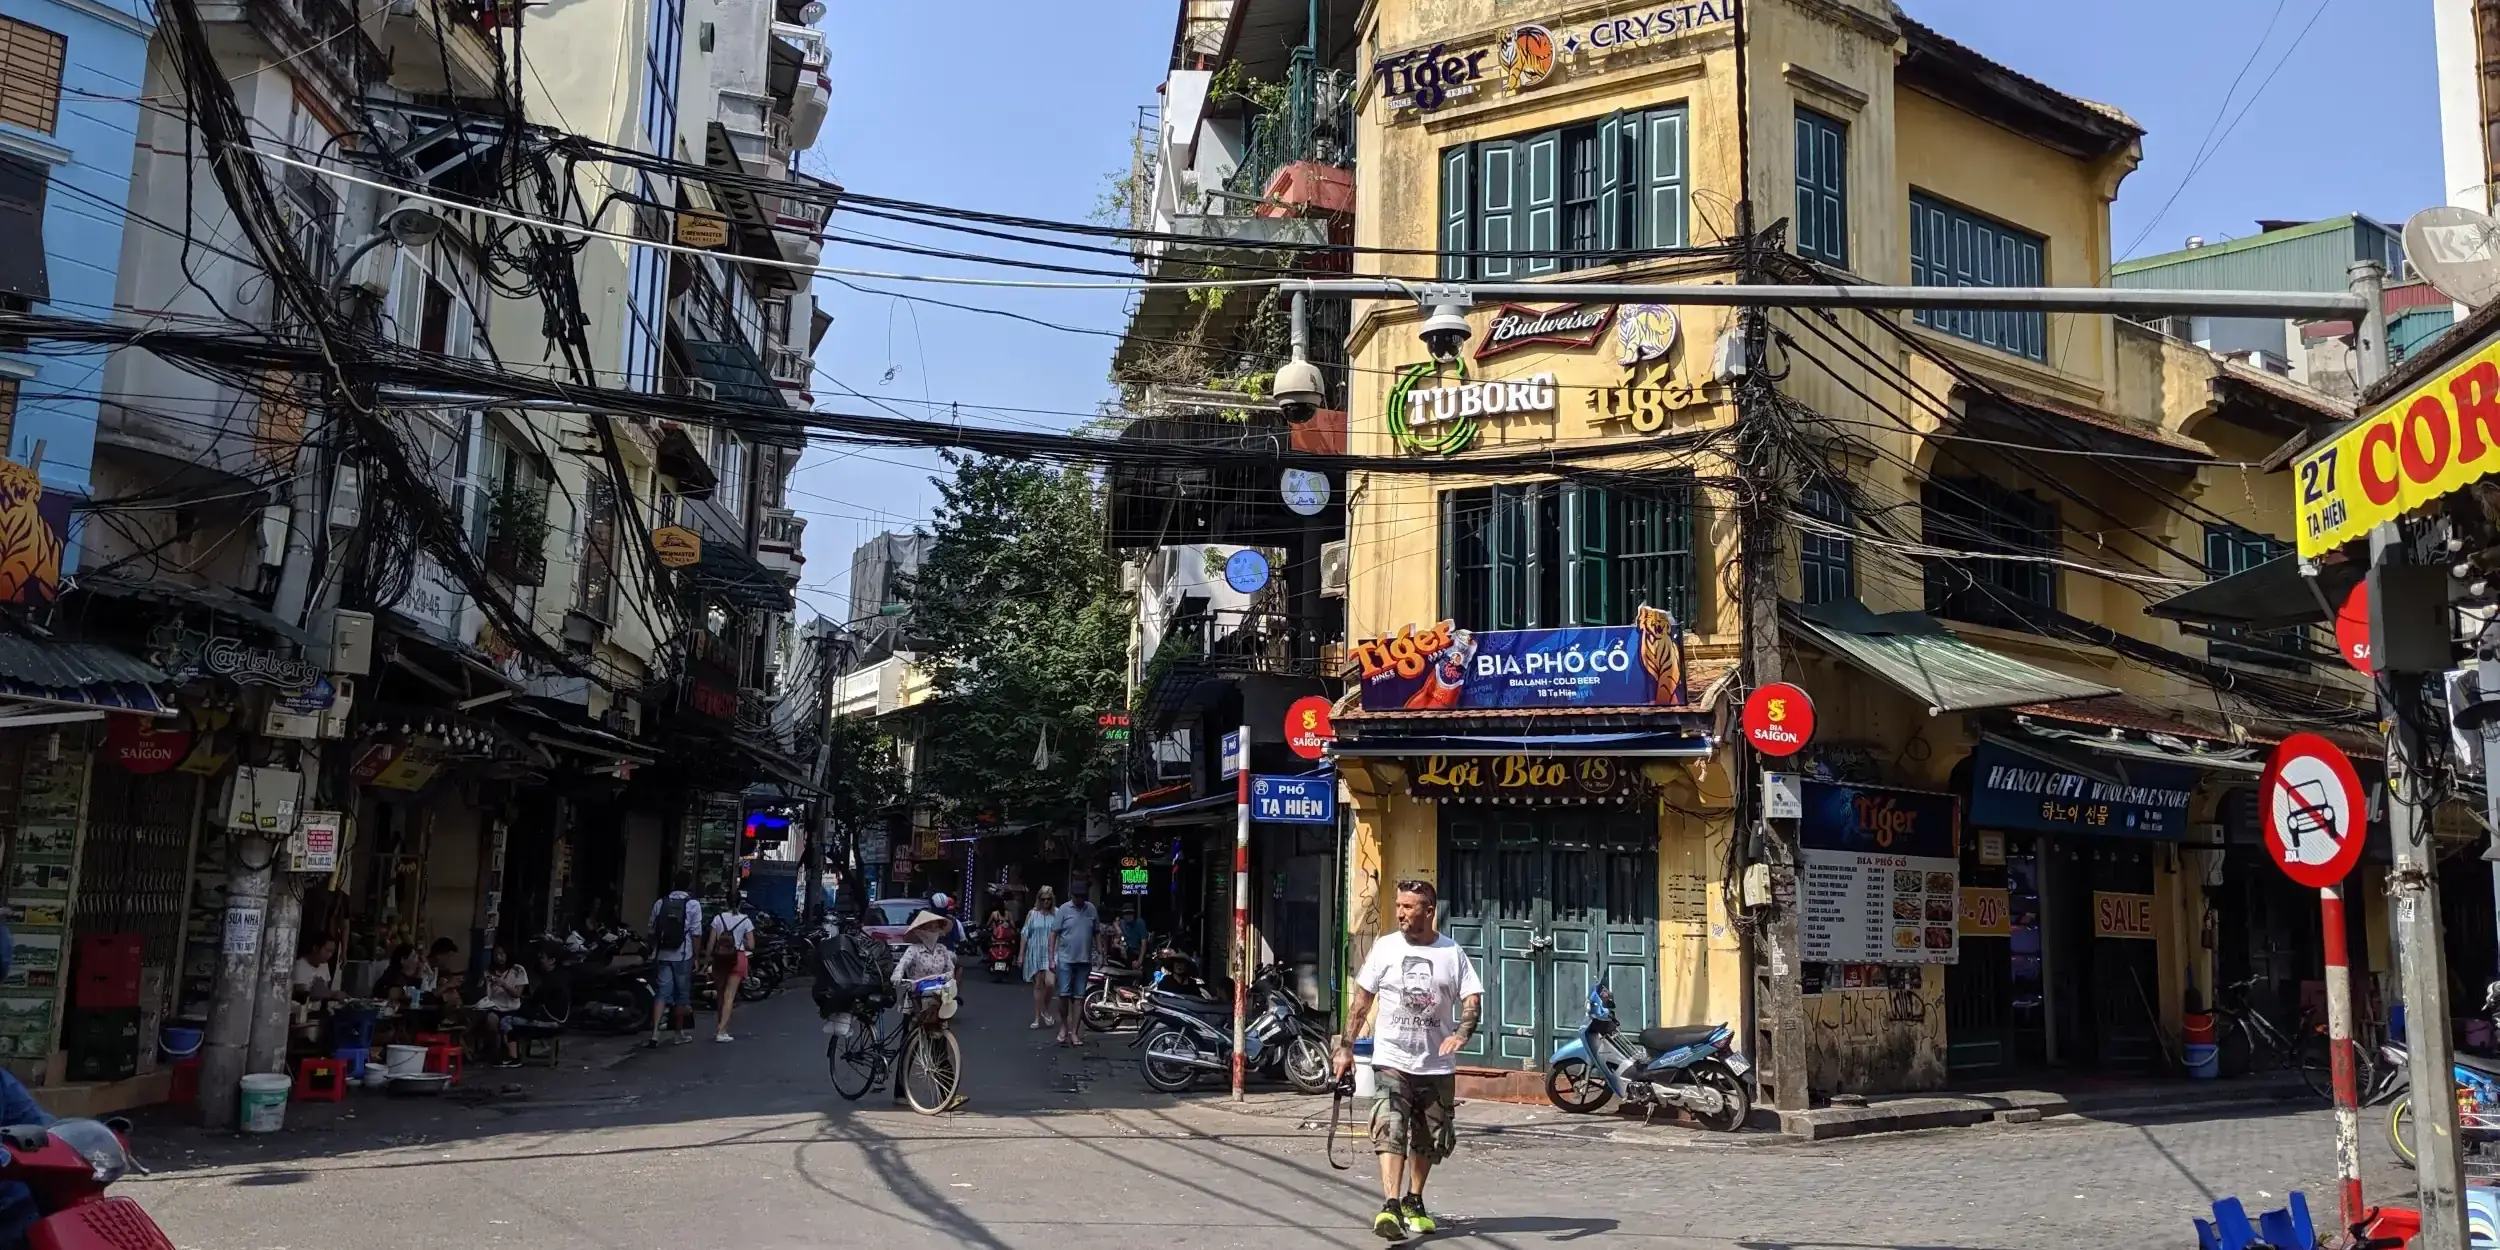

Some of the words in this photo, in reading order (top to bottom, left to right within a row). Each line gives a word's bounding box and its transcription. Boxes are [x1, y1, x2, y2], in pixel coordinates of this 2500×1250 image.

[1589, 0, 1735, 48] CRYSTAL
[1372, 43, 1489, 110] Tiger
[1387, 99, 1412, 108] SINCE
[1489, 309, 1606, 342] Budweiser
[1407, 371, 1557, 427] TUBORG
[1587, 362, 1717, 432] Tiger
[2300, 446, 2338, 507] 27
[2306, 513, 2321, 541] TẠ
[2322, 498, 2347, 531] HIỆN
[204, 635, 321, 685] Carlsberg
[1347, 618, 1456, 680] Tiger
[1476, 654, 1522, 677] BIA
[1525, 643, 1585, 674] PHỐ
[1589, 639, 1630, 672] CỔ
[1370, 668, 1396, 684] SINCE
[1509, 679, 1524, 687] BIA
[1553, 678, 1577, 686] COLD
[1577, 676, 1600, 685] BEER
[1538, 689, 1547, 697] 18
[1548, 689, 1558, 698] Tạ
[1293, 737, 1323, 747] SAIGO
[1754, 729, 1798, 743] SAIGON
[1769, 724, 1783, 732] BIA
[120, 747, 172, 760] SAIGON
[1228, 738, 1237, 750] PHỐ
[1418, 755, 1484, 794] Lợi
[1492, 755, 1571, 787] Béo
[1578, 756, 1609, 781] 18
[1278, 782, 1306, 795] PHỐ
[1988, 765, 2046, 794] HANOI
[2047, 772, 2087, 798] GIFT
[2092, 781, 2157, 806] WHOLESALE
[2156, 788, 2191, 809] STORE
[1260, 798, 1280, 817] TẠ
[1285, 796, 1323, 818] HIỆN
[2042, 801, 2080, 824] 하노이
[2084, 805, 2109, 826] 선물
[1853, 796, 1918, 848] Tiger
[1856, 856, 1872, 865] BIA
[1875, 856, 1892, 866] PHỐ
[1894, 857, 1908, 867] CỔ
[2100, 898, 2150, 933] SALE
